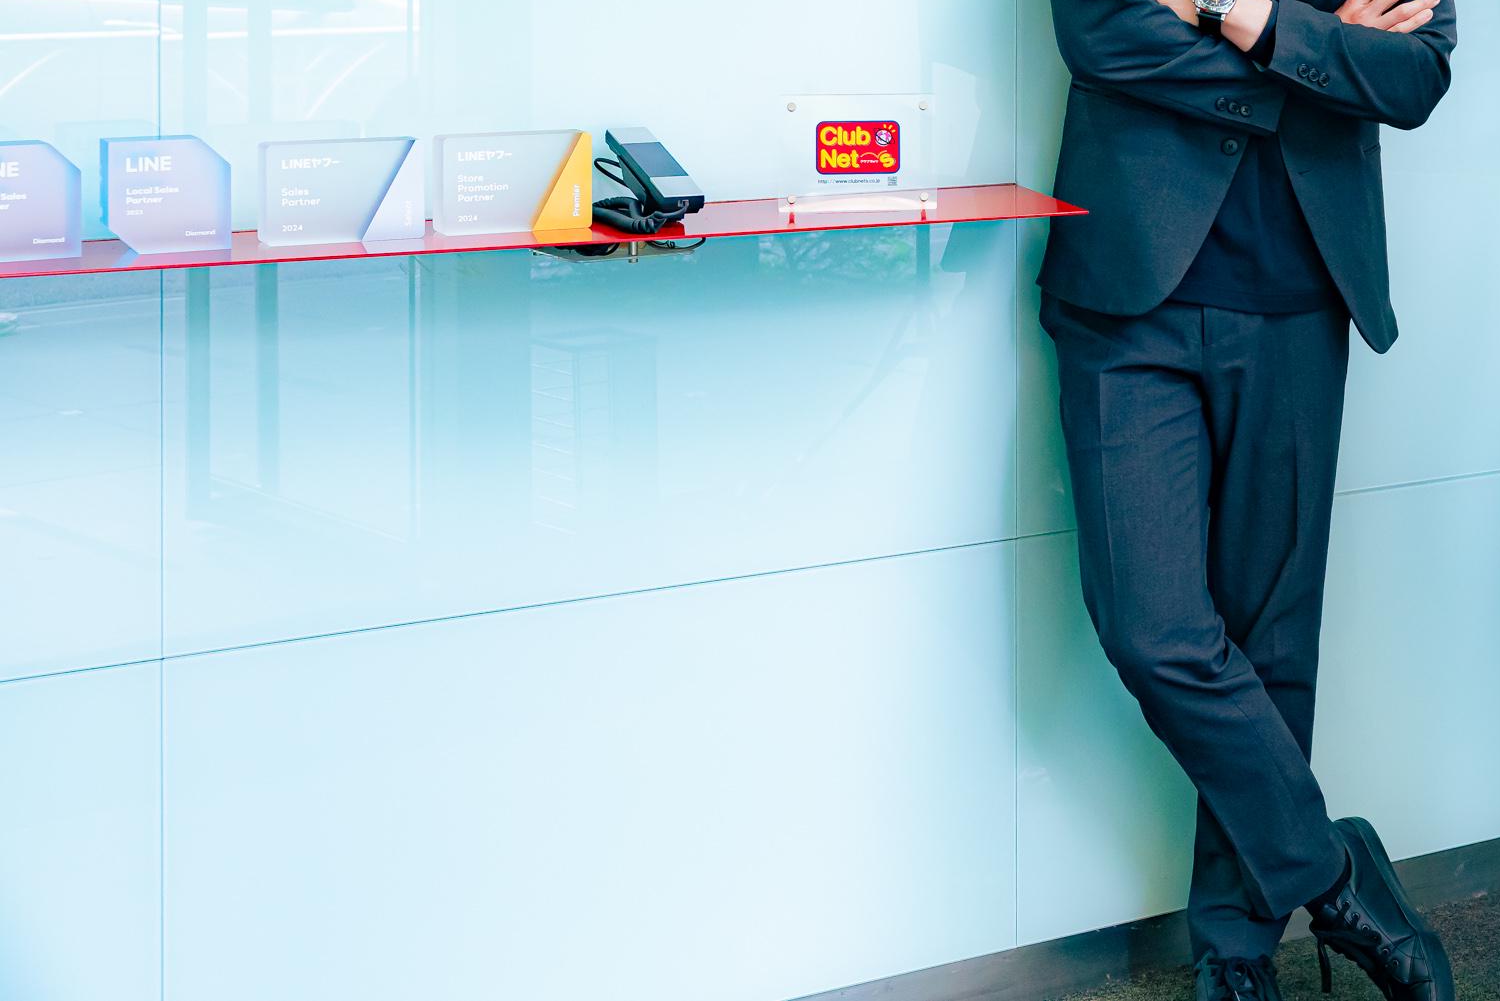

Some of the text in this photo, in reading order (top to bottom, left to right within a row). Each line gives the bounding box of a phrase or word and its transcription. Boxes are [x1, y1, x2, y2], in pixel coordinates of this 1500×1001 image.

[819, 126, 871, 146] Club
[125, 155, 172, 173] LINE
[281, 157, 340, 169] LINEヤフー
[457, 174, 483, 183] Store
[126, 186, 179, 195] Local Sales
[281, 187, 309, 197] Sales
[457, 182, 509, 193] Promotion
[126, 197, 163, 205] Partner
[457, 193, 494, 202] Partner
[573, 183, 581, 217] Premier
[281, 198, 320, 207] Partner
[458, 214, 478, 222] 2024
[282, 224, 303, 232] 2024
